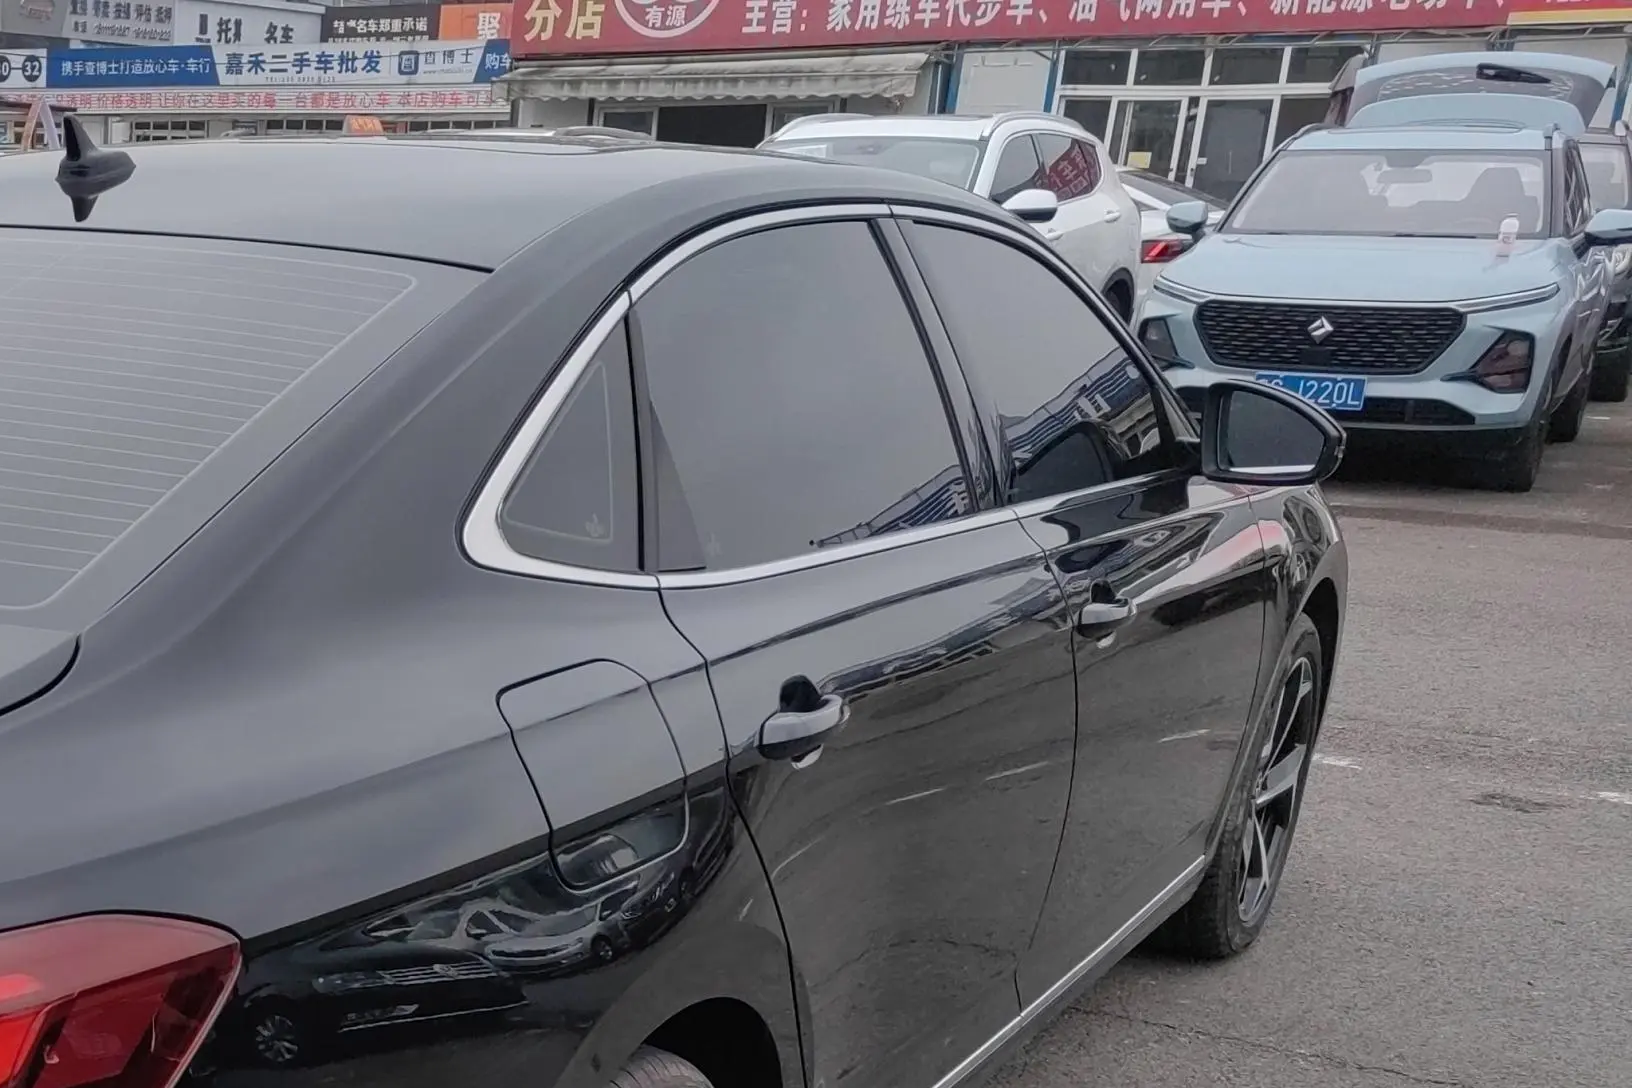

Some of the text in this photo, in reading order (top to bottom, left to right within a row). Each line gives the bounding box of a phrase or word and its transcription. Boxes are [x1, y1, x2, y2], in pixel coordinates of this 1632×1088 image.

[645, 4, 687, 28] 有源
[61, 58, 211, 76] 携手查博士打造放心车·车行
[225, 50, 382, 75] 嘉禾二手车批发
